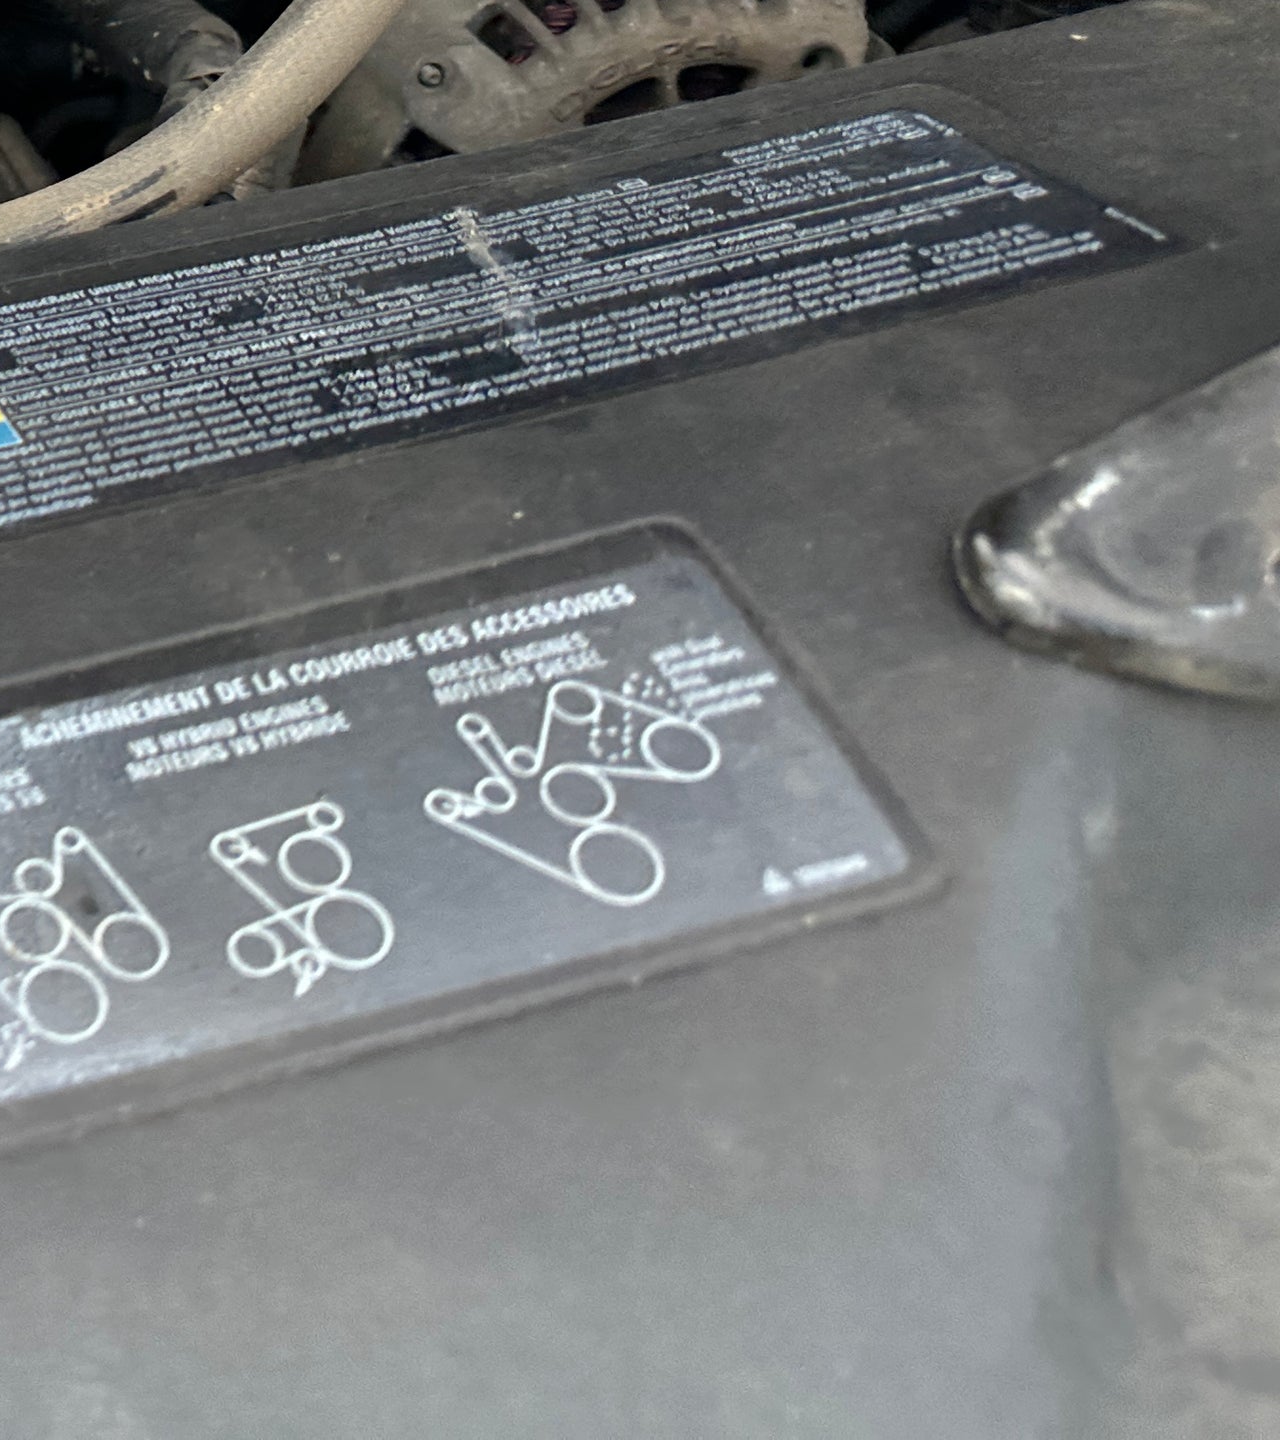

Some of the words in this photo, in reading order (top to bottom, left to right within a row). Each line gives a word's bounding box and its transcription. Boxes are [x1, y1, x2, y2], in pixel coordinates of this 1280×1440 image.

[90, 282, 136, 293] UNDER
[139, 273, 174, 284] HIGH
[176, 260, 246, 276] PRESSURE
[279, 247, 300, 256] Air
[207, 346, 249, 360] SOUS
[251, 336, 299, 349] HAUTE
[301, 320, 372, 339] PRESSION
[20, 688, 210, 748] ACHEMINEMENT
[215, 678, 249, 700] DE
[253, 670, 284, 690] LA
[290, 639, 415, 682] COURROIE
[417, 626, 467, 651] DES
[470, 585, 635, 637] ACCESSOIRES
[428, 655, 498, 682] DIESEL
[501, 633, 589, 664] ENGINES
[433, 668, 535, 704] MOTEURS
[535, 651, 607, 679] DIESEL
[127, 742, 228, 780] MOTEURS
[259, 713, 350, 748] HYBRIDE
[160, 719, 237, 750] HYBRID
[240, 697, 328, 730] ENGINES
